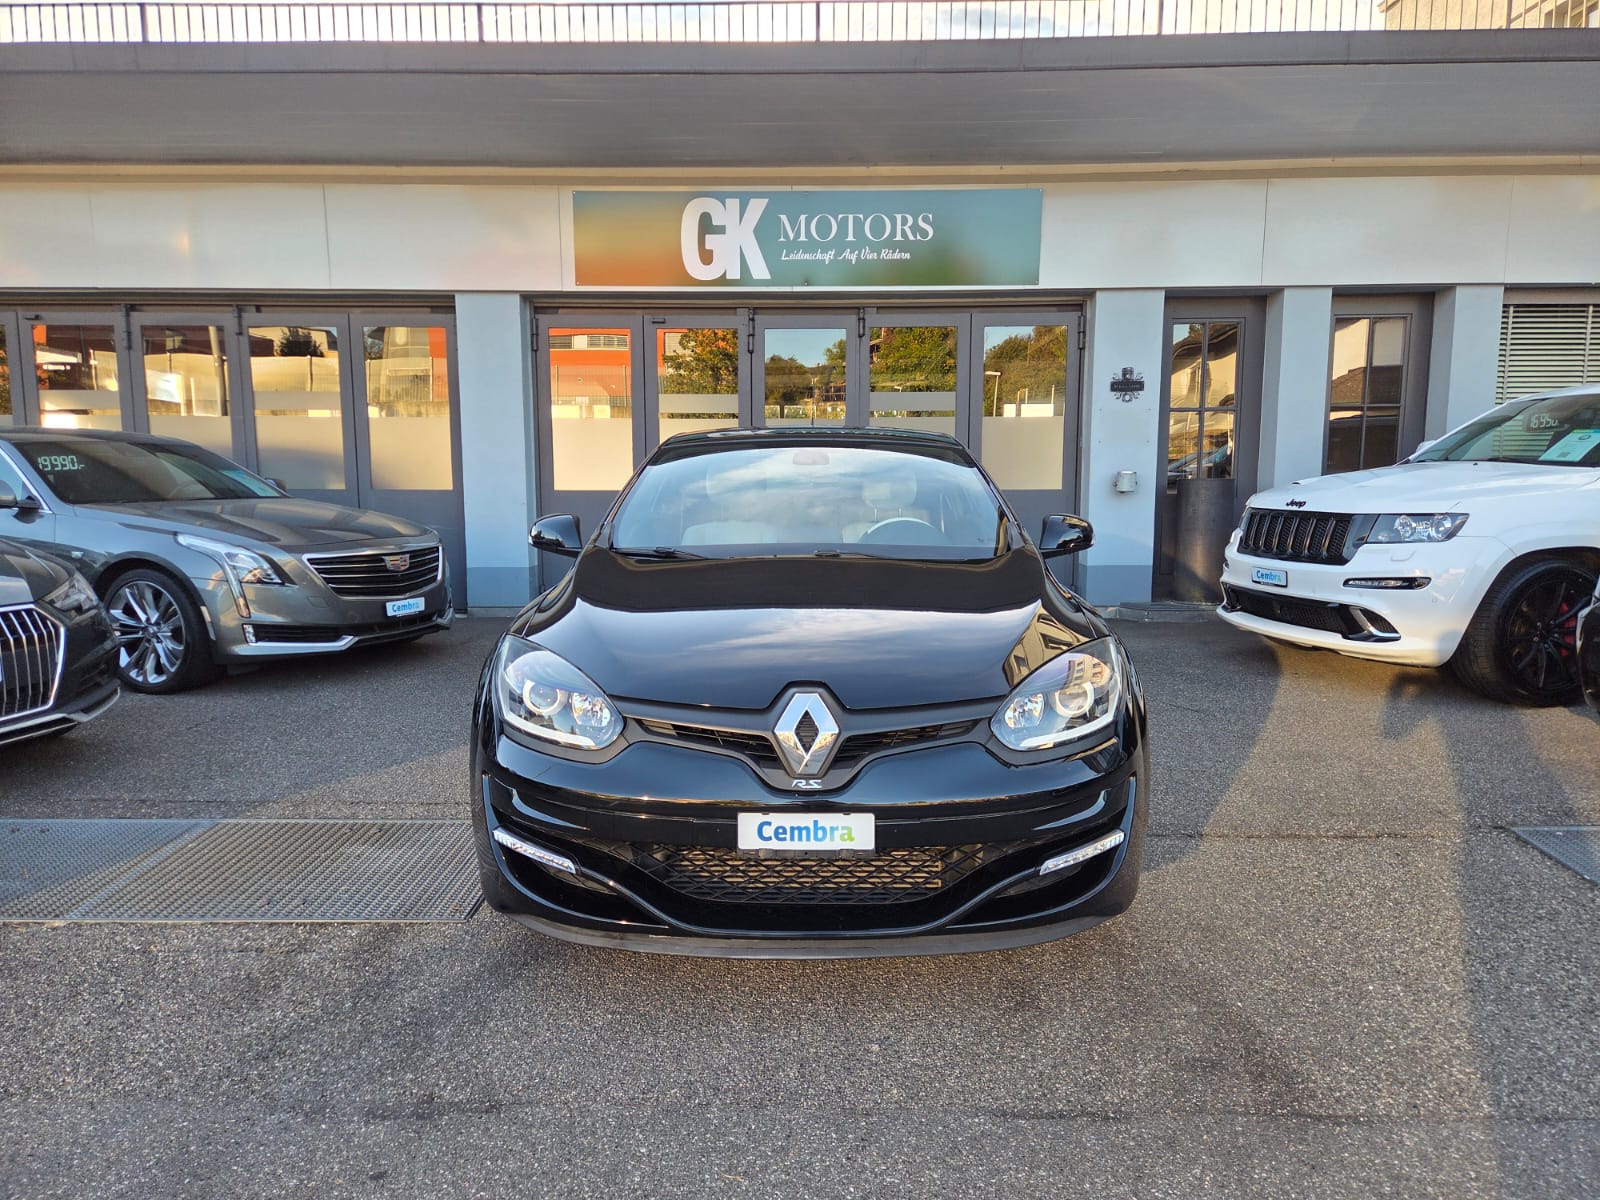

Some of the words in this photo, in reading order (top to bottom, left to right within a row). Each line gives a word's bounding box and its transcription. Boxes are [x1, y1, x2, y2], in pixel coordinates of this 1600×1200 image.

[680, 197, 771, 281] GK
[777, 212, 934, 242] MOTORS
[781, 248, 836, 264] Leidenschaft
[837, 248, 859, 264] Auf
[860, 246, 878, 260] Vier
[880, 248, 911, 260] Rädern
[1286, 499, 1307, 508] Jeep
[1256, 570, 1282, 582] Cembra
[391, 602, 420, 613] Cembra
[792, 780, 822, 788] RS
[757, 820, 855, 842] Cembra
